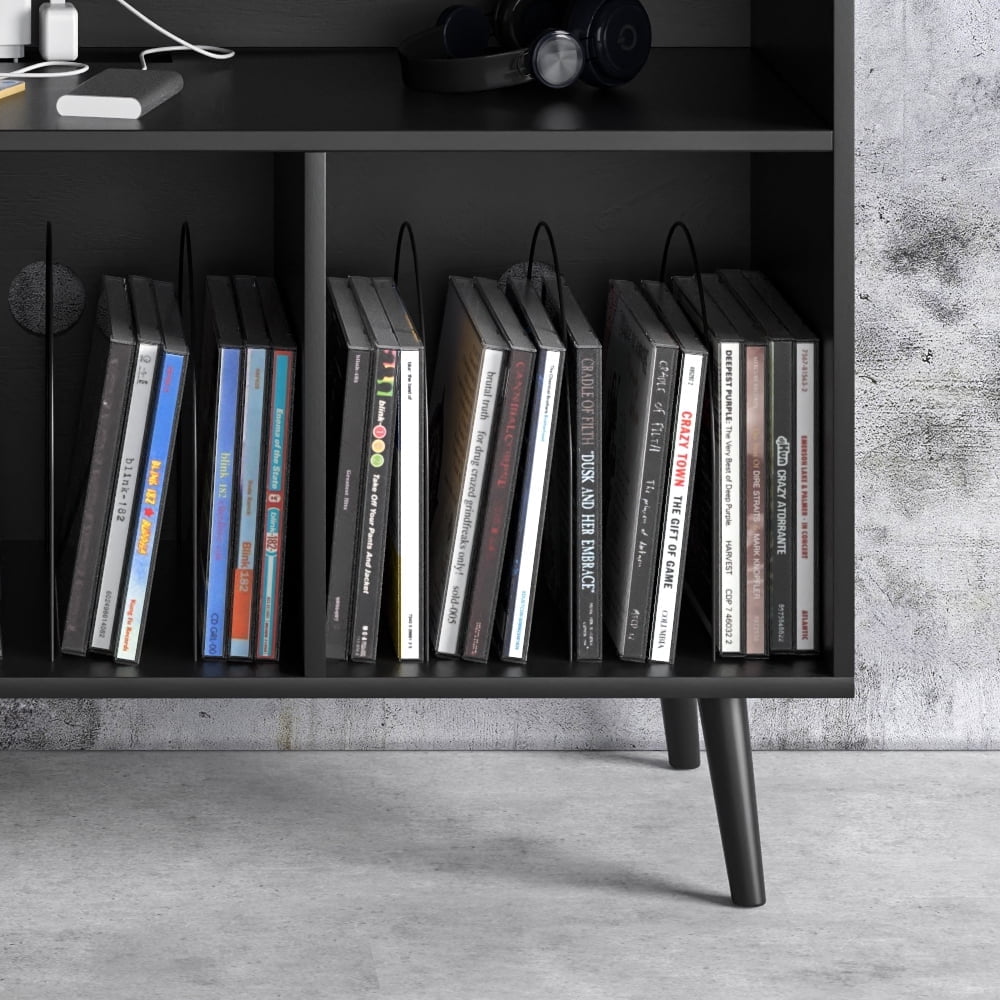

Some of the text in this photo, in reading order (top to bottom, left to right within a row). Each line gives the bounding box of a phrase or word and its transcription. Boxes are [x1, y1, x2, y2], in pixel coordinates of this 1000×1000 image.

[581, 359, 595, 398] CRADLE
[725, 351, 733, 388] DEEPEST
[582, 401, 595, 414] OF
[725, 390, 733, 425] PURPLE:
[275, 409, 284, 438] Enema
[582, 417, 595, 446] FILTH
[274, 440, 282, 449] of
[219, 454, 231, 479] blink
[273, 452, 282, 464] the
[725, 458, 733, 474] Best
[116, 457, 135, 522] blink-182
[272, 467, 281, 491] State
[371, 475, 380, 493] Take
[777, 470, 786, 500] CRAZY
[218, 484, 228, 499] 182
[370, 495, 379, 507] Off
[447, 372, 497, 625] brutal truth for drug crazed grindfreaks only! sold-005
[581, 488, 595, 509] AND
[663, 411, 693, 589] CRAZY TOWN THE GIFT OF GAME
[724, 484, 733, 503] Deep
[368, 509, 377, 527] Your
[582, 515, 595, 538] HER
[777, 501, 787, 556] ATORRANTE
[366, 529, 375, 552] Pants
[239, 542, 252, 592] Blink 182
[365, 553, 373, 569] And
[725, 541, 733, 576] HARVEST
[362, 571, 372, 596] Jacket
[725, 589, 733, 605] CDP
[211, 614, 219, 626] CD
[658, 611, 669, 649] COLUMBIA
[725, 614, 733, 638] 46032
